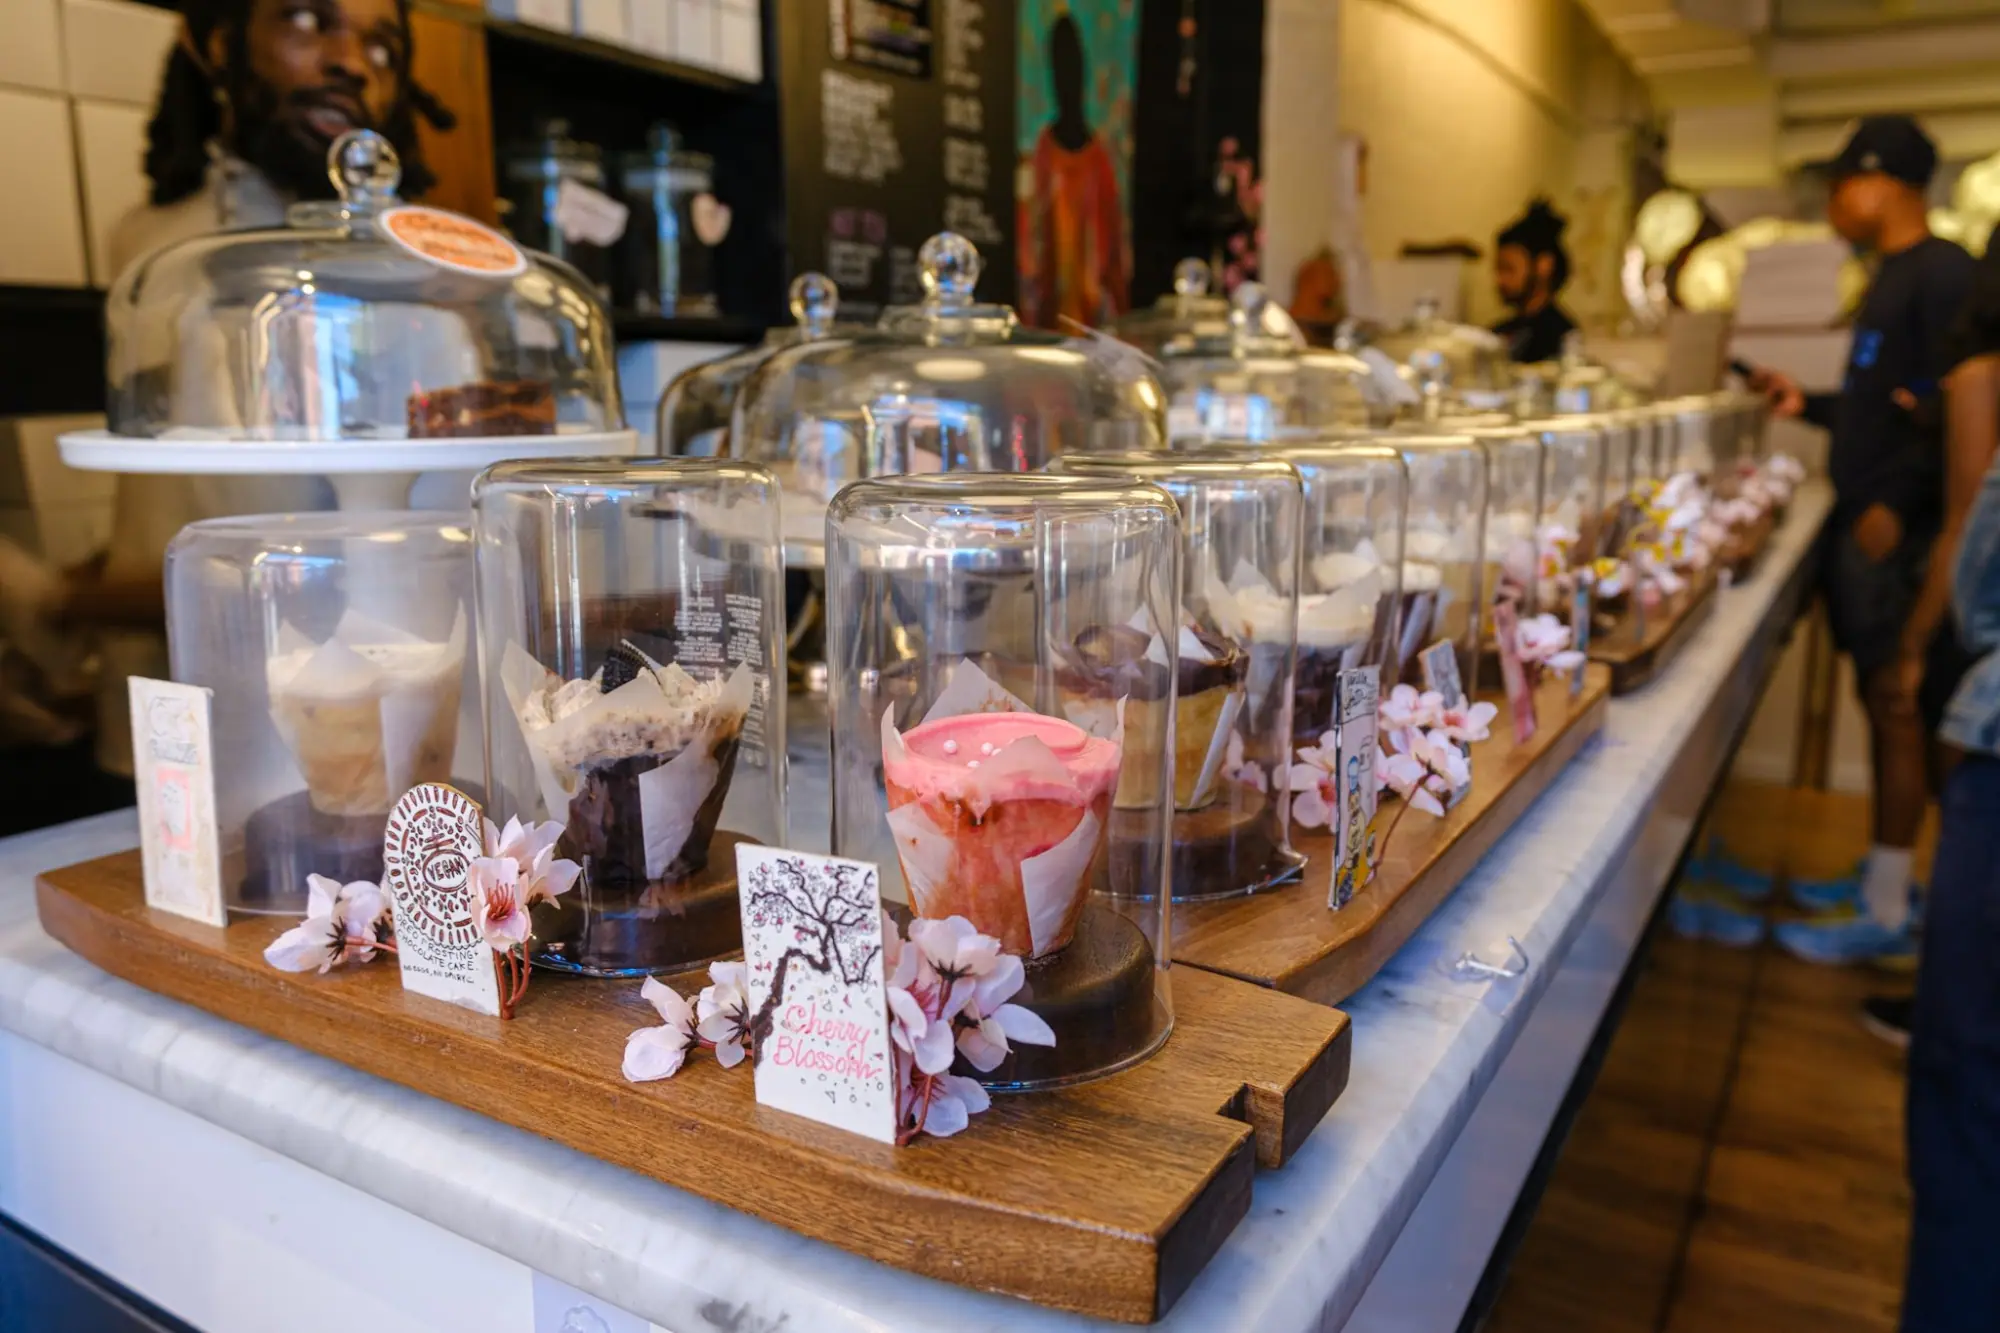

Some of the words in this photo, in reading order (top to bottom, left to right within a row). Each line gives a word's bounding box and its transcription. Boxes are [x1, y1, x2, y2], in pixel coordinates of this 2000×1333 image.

[427, 856, 466, 881] VEGAN
[396, 914, 419, 939] OREO
[397, 929, 445, 968] CHOCOLATE
[785, 1003, 870, 1064] Cherry
[773, 1036, 882, 1079] Blossom
